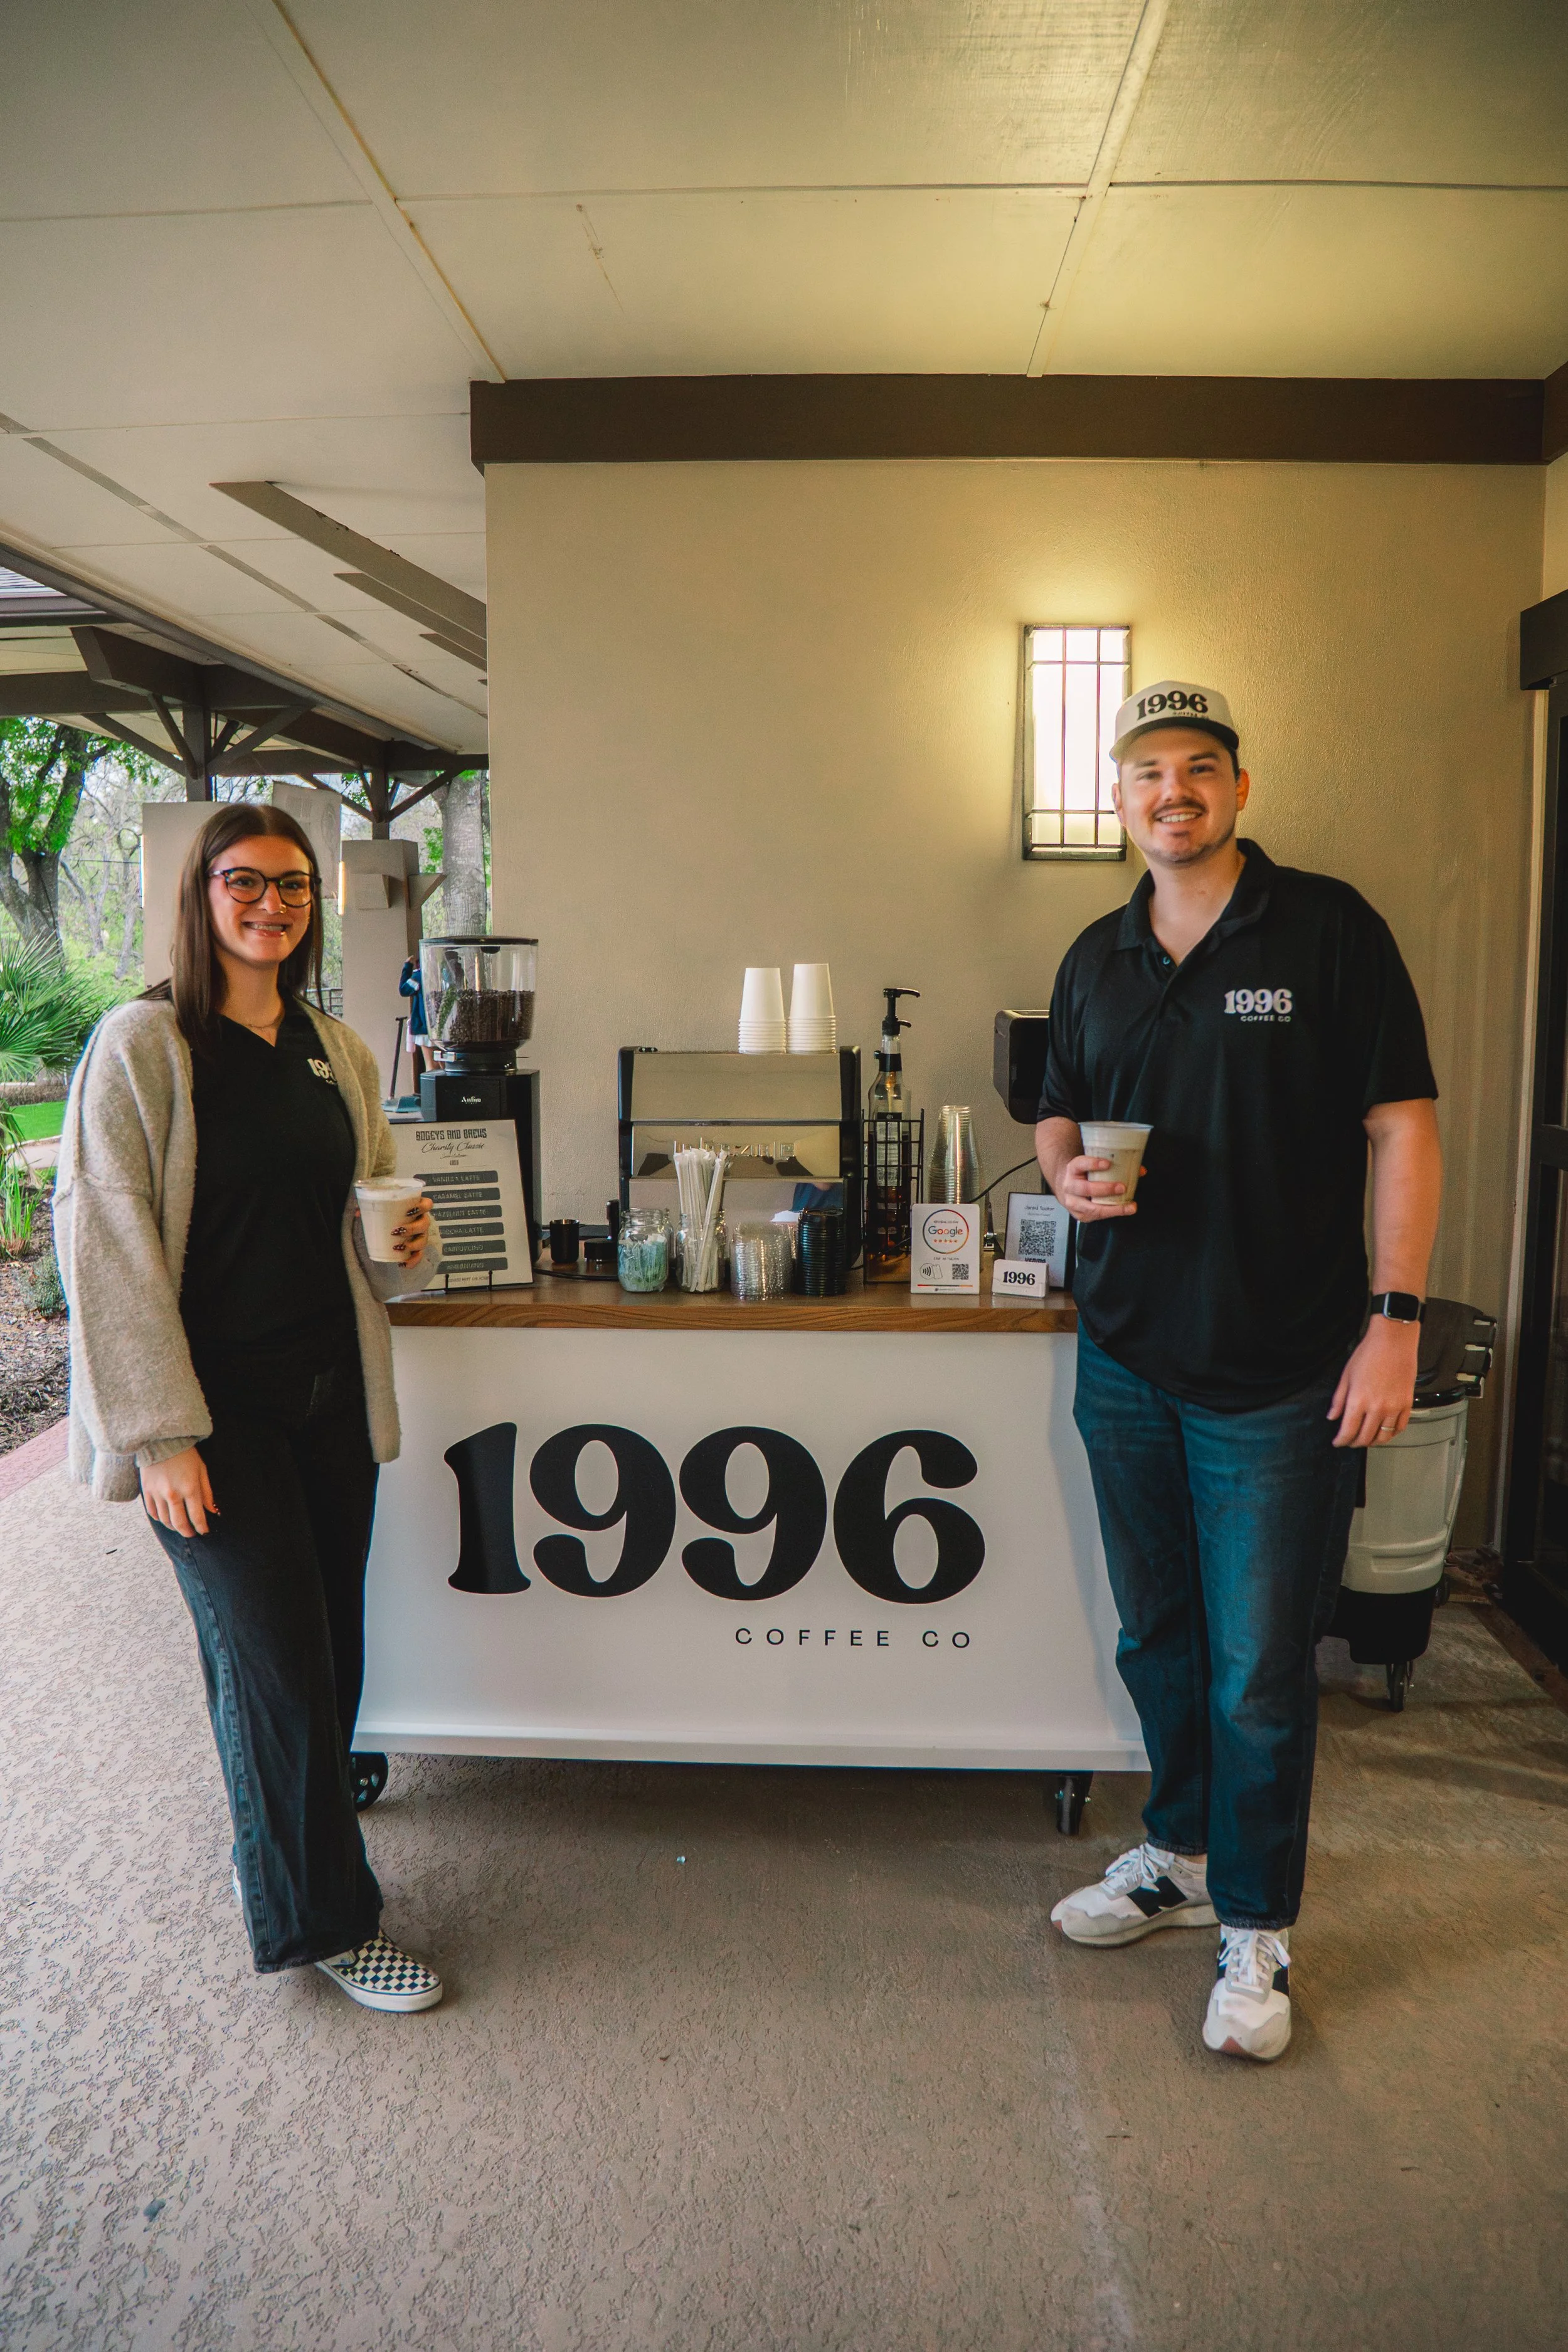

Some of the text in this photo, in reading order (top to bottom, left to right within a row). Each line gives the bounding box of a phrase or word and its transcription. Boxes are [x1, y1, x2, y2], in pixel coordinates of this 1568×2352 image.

[1137, 690, 1209, 721] 1996
[1224, 988, 1293, 1014] 1996
[416, 1128, 487, 1141] BOGEYS AND BREWS
[421, 1142, 455, 1153] Charity
[928, 1226, 963, 1237] Google
[1003, 1271, 1036, 1285] 1996
[444, 1422, 985, 1604] 1996
[735, 1627, 970, 1649] COFFEE CO
